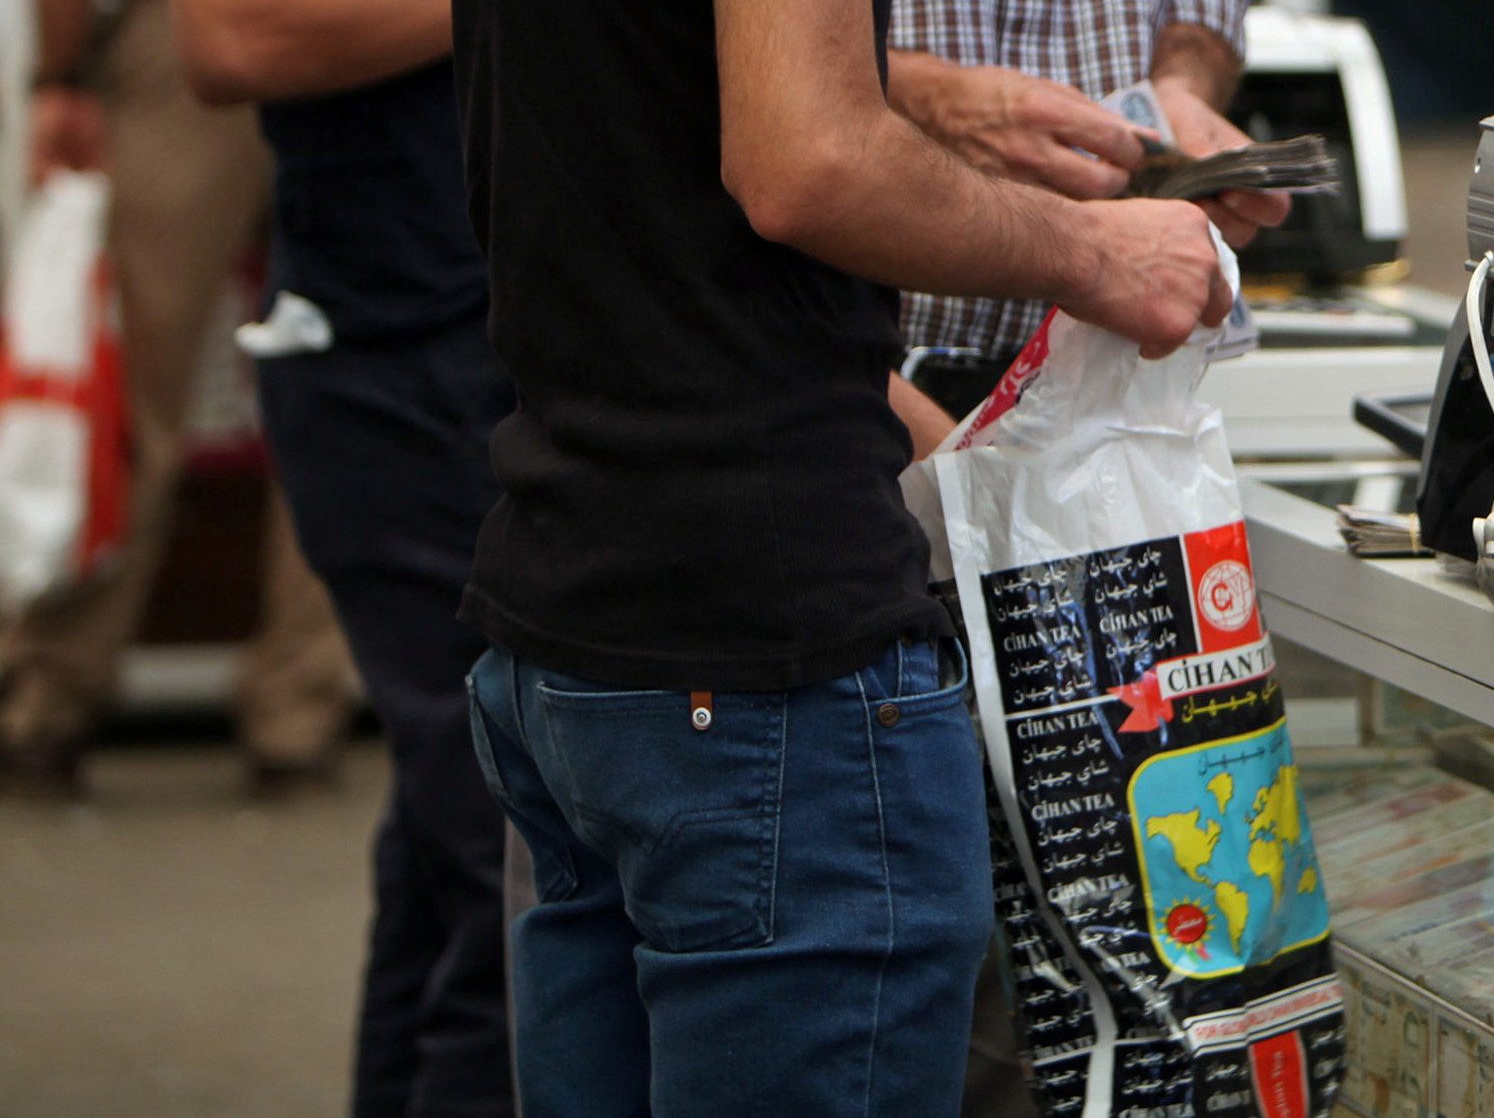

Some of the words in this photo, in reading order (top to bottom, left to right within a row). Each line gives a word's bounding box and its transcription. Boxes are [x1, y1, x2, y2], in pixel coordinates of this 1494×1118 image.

[1150, 604, 1175, 625] TEA
[1050, 624, 1082, 645] TEA
[1067, 711, 1100, 731] TEA
[1083, 792, 1116, 814] TEA
